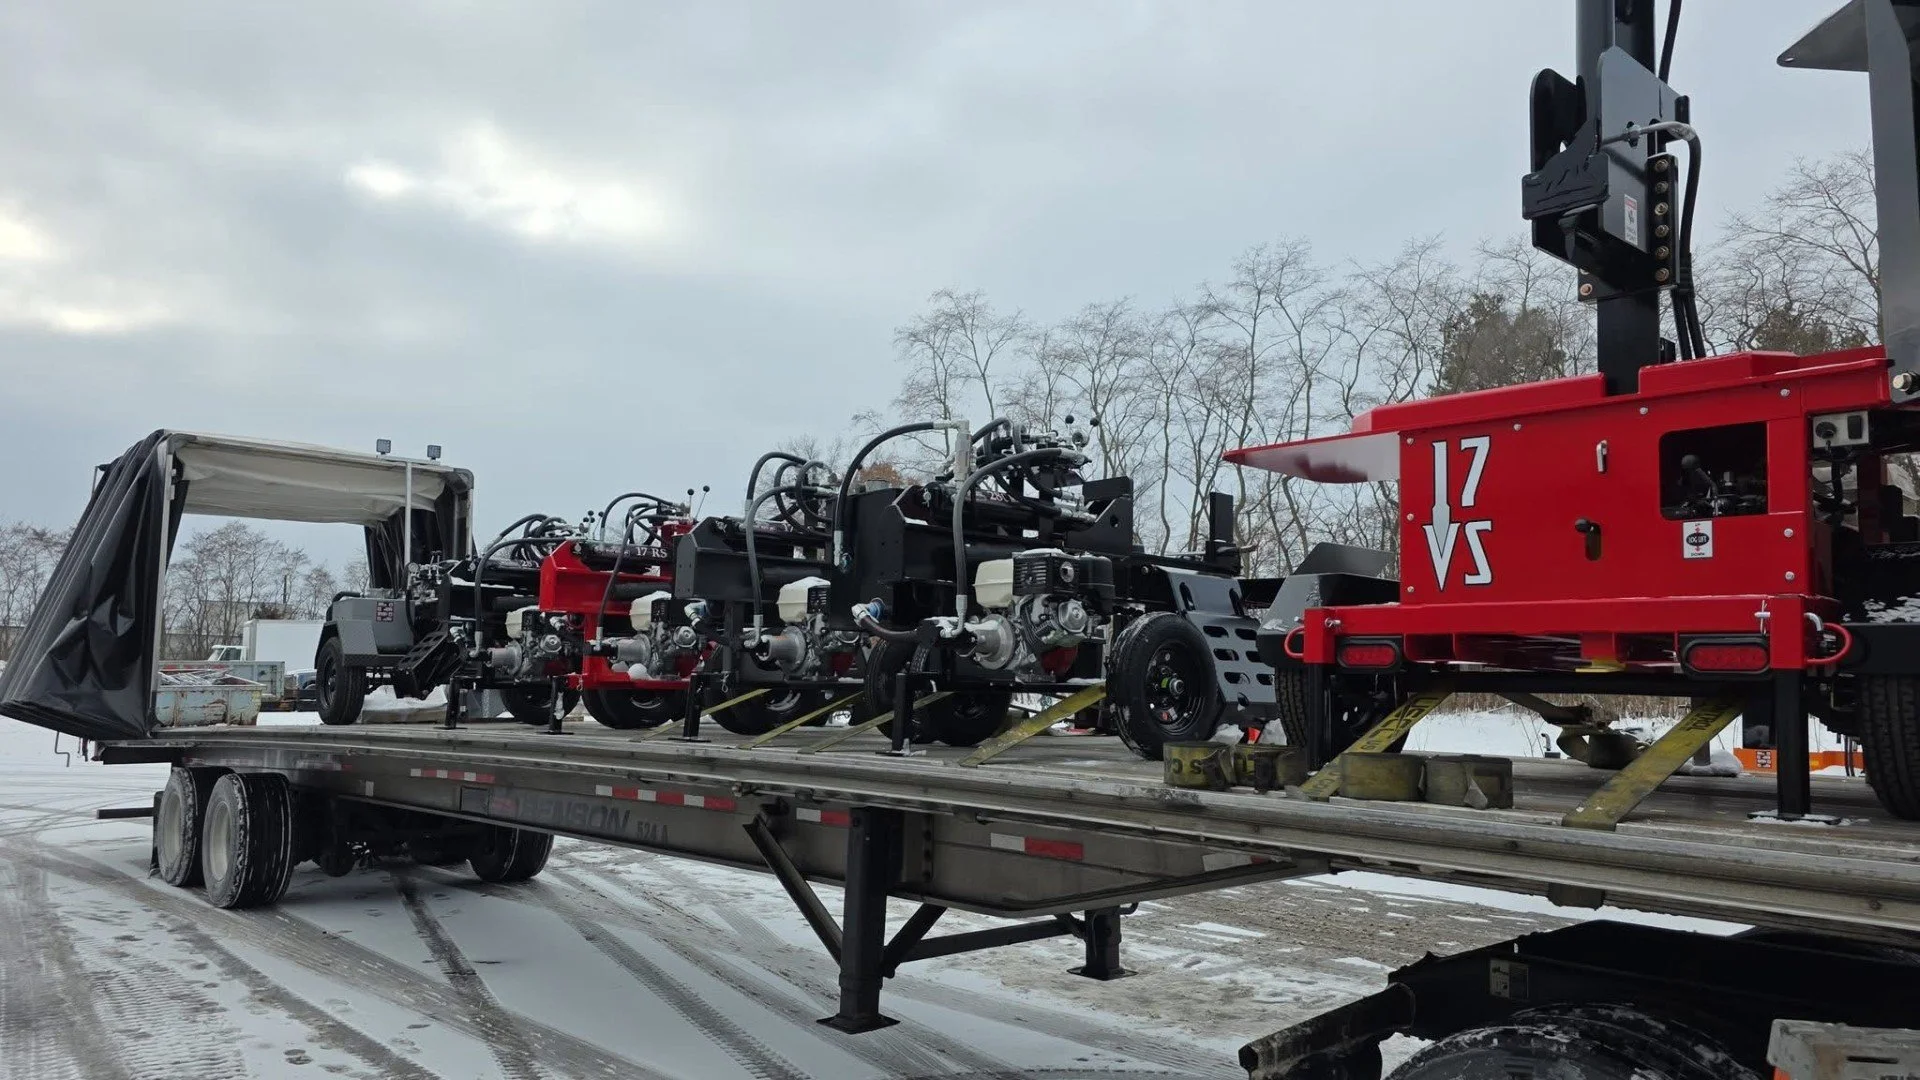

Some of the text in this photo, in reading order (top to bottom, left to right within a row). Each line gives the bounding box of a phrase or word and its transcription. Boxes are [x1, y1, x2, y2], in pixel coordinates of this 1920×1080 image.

[1432, 436, 1490, 508] 17
[636, 547, 648, 556] 17
[652, 548, 667, 558] RS
[1422, 520, 1493, 591] VS
